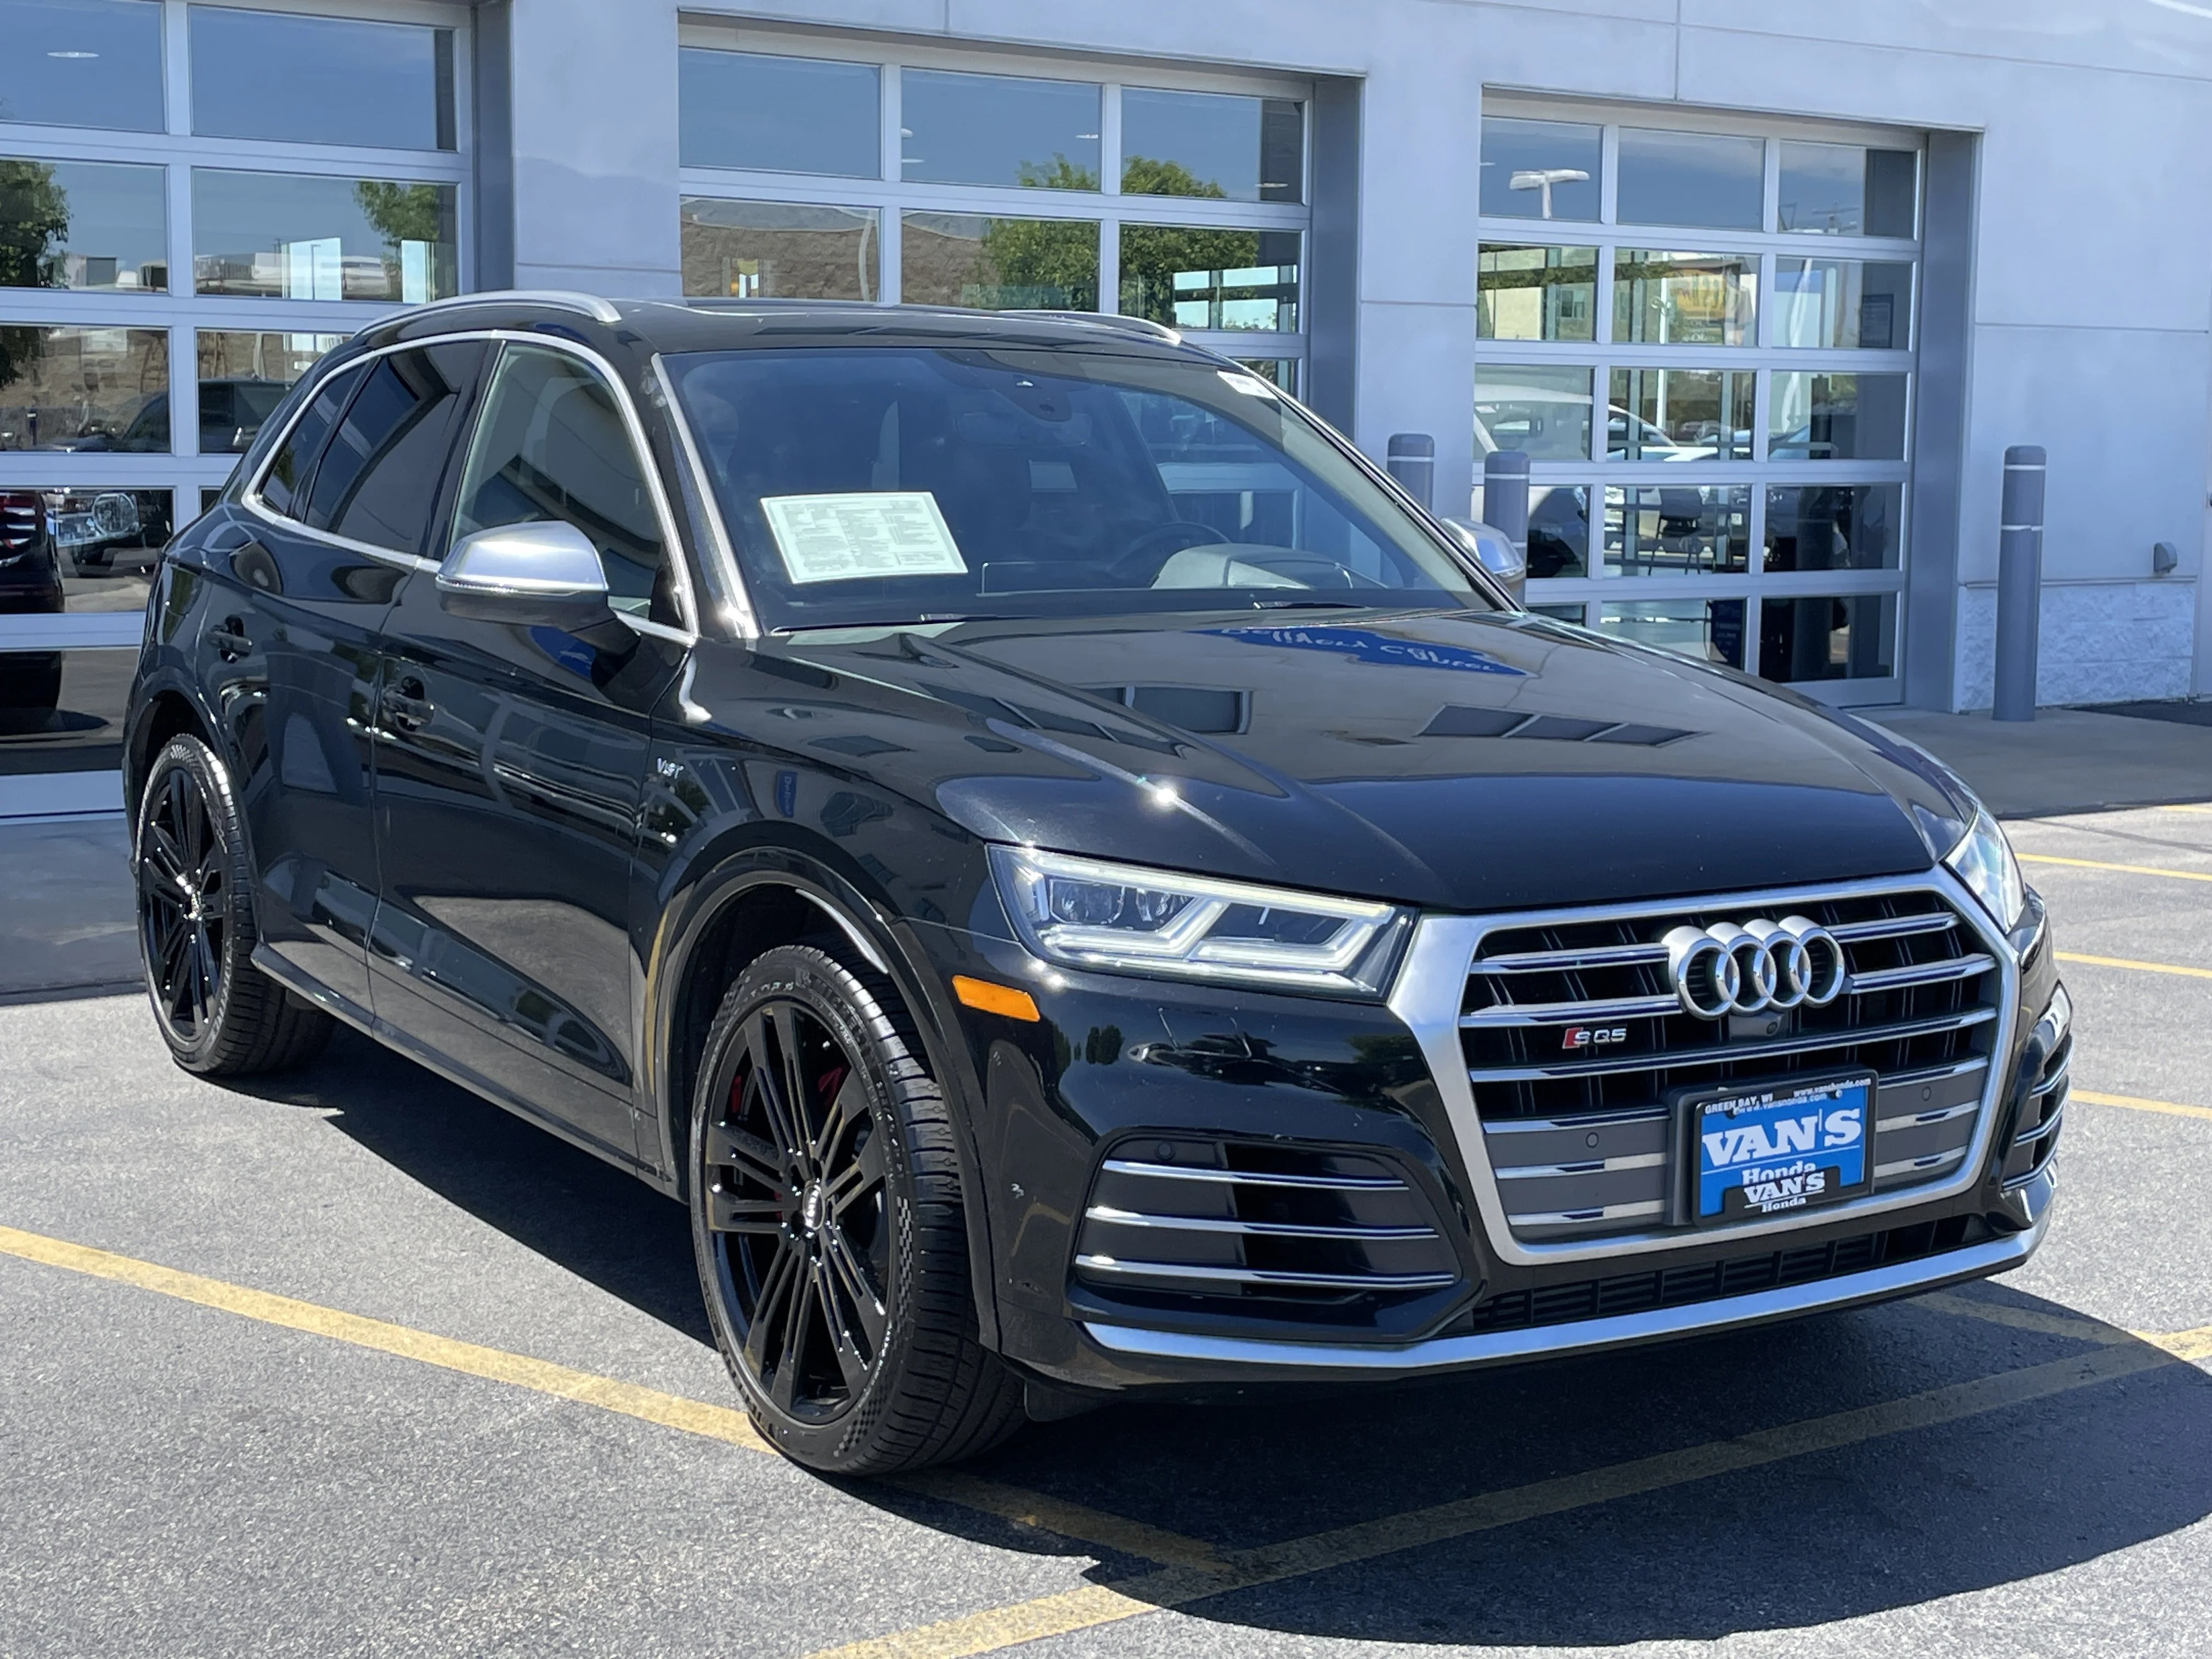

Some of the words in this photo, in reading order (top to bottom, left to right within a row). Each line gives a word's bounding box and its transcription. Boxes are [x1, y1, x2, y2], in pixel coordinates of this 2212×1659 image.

[1573, 1028, 1627, 1045] SQ5
[1705, 1099, 1736, 1115] GREEN
[1760, 1092, 1774, 1103] WI
[1702, 1108, 1861, 1167] VAN'S
[1742, 1161, 1817, 1186] Honda
[1743, 1171, 1825, 1204] VAN'S
[1762, 1195, 1807, 1214] Honda
